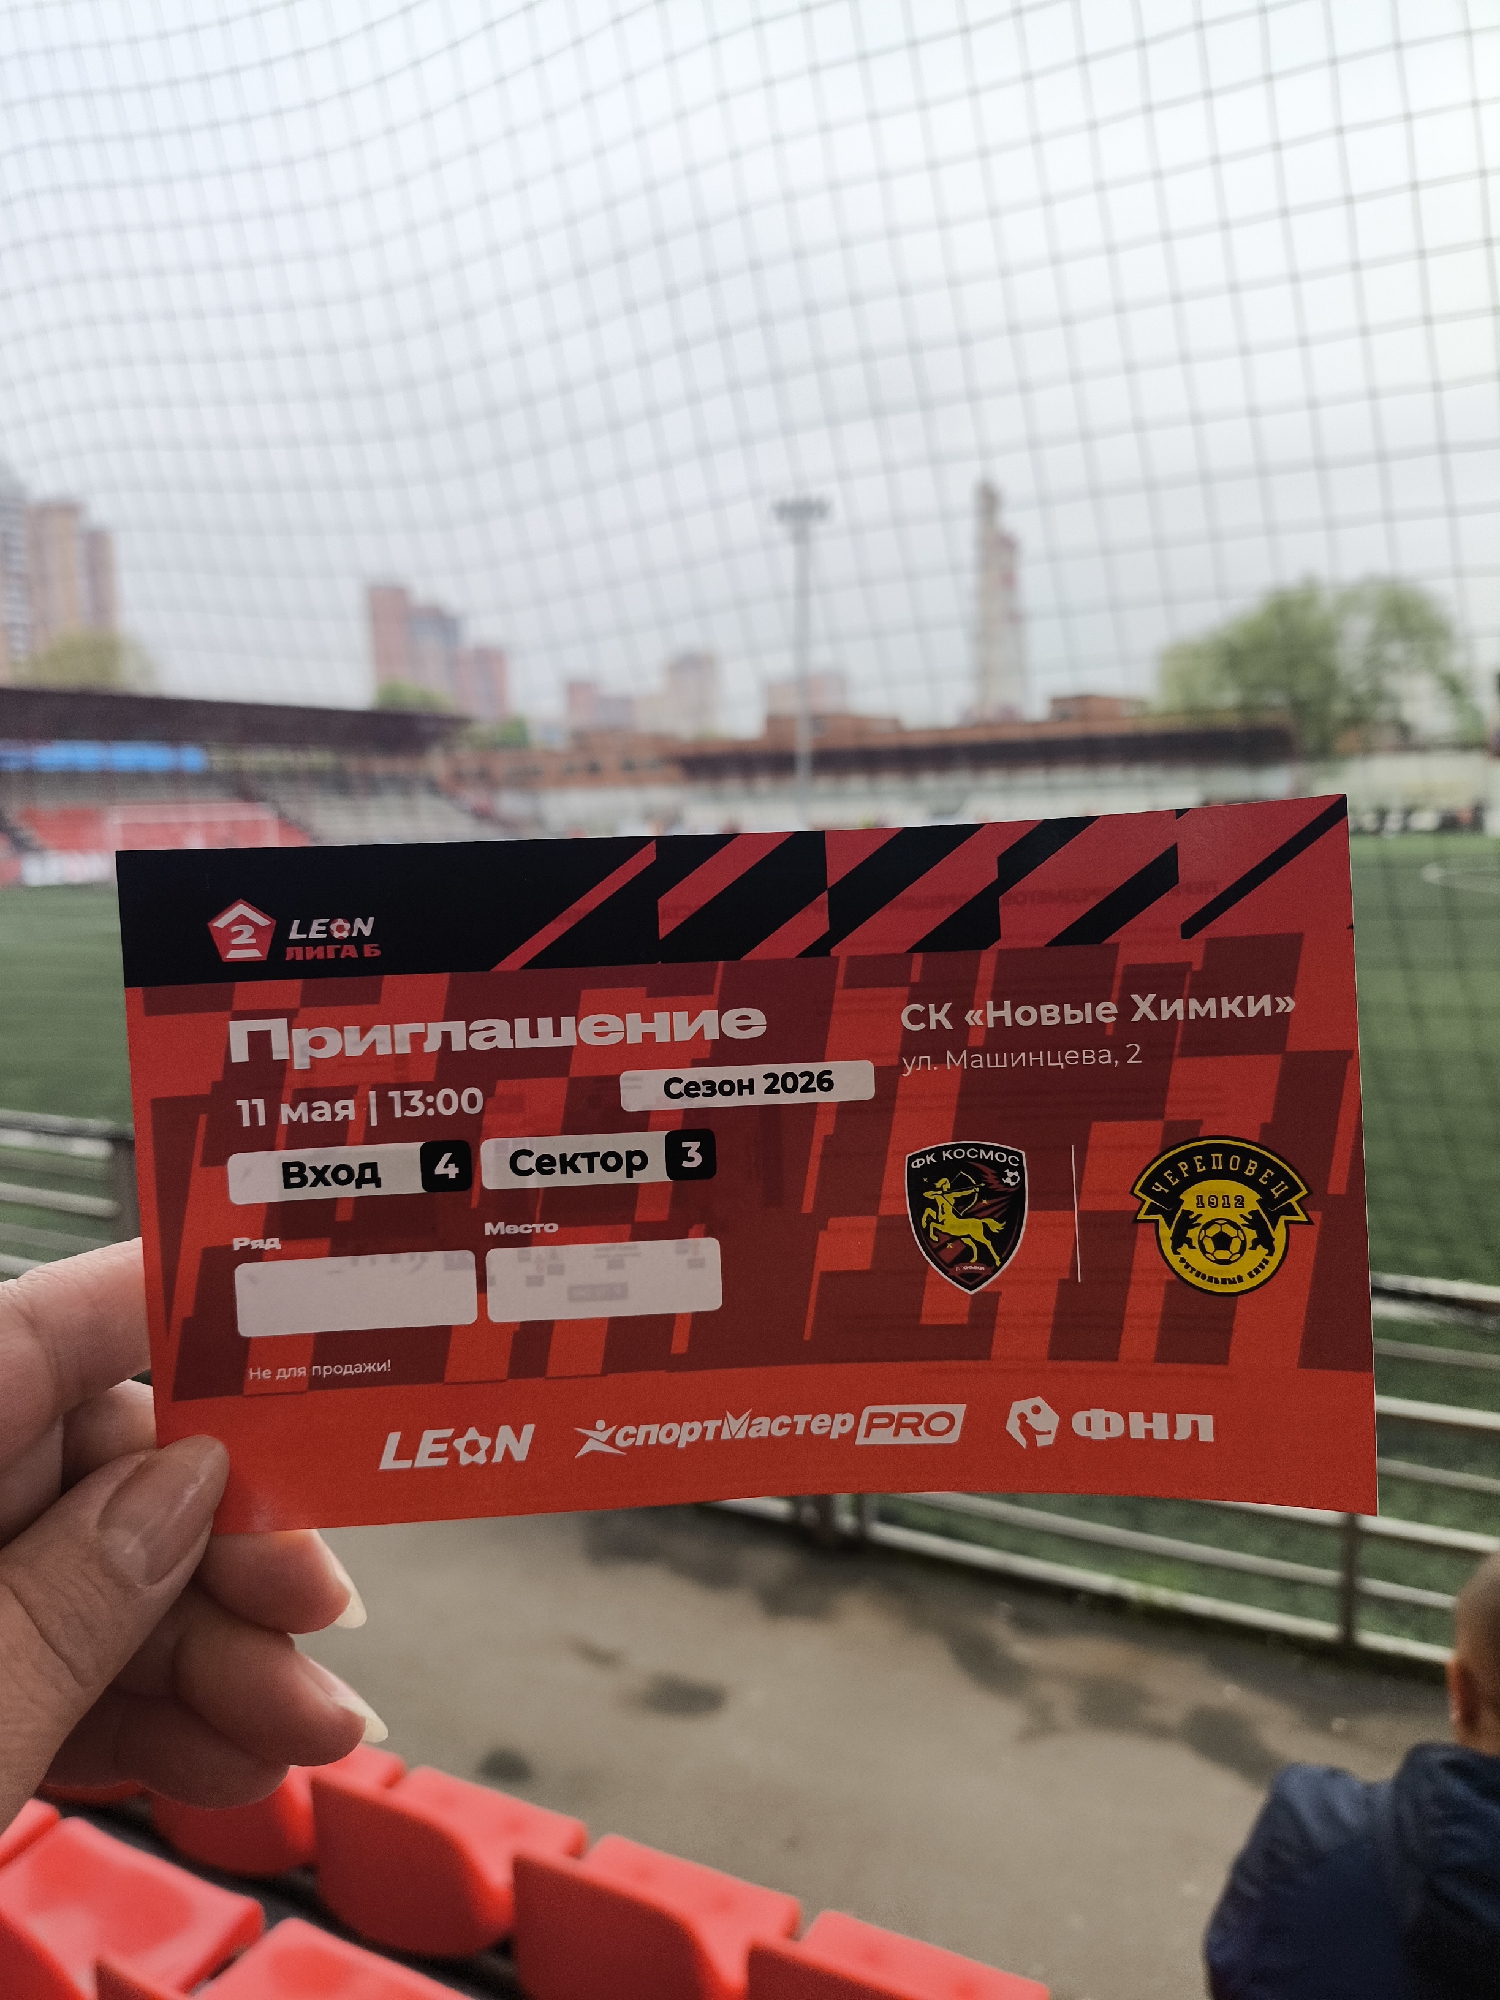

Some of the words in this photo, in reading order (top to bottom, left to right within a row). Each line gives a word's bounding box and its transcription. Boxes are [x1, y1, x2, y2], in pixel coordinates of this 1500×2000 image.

[229, 924, 257, 945] 2
[285, 944, 358, 961] ЛИГА
[363, 943, 382, 958] Б
[901, 1002, 953, 1031] СК
[964, 1000, 1118, 1028] «Новые
[1130, 993, 1296, 1022] Химки»
[228, 1007, 767, 1070] Приглашение
[902, 1052, 938, 1077] ул.
[946, 1046, 1119, 1071] Машинцева,
[1126, 1043, 1143, 1064] 2
[663, 1076, 755, 1100] Сезон
[763, 1069, 835, 1095] 2026
[236, 1098, 266, 1127] 11
[280, 1099, 356, 1126] мая
[388, 1086, 484, 1118] 13:00
[281, 1160, 382, 1190] Вход
[434, 1152, 460, 1179] 4
[509, 1148, 649, 1179] Сектор
[680, 1141, 703, 1168] 3
[911, 1152, 937, 1169] ФК
[942, 1147, 1020, 1167] КОСМОС
[1151, 1153, 1289, 1199] ЧЕРЕПОВЕЦ
[1196, 1194, 1245, 1208] 1912
[233, 1237, 281, 1250] Ряд
[484, 1221, 559, 1236] Место
[249, 1367, 272, 1380] Не
[276, 1364, 307, 1380] для
[312, 1359, 392, 1377] продажи!
[862, 1410, 956, 1439] PRO
[1071, 1408, 1214, 1442] ФНЛ
